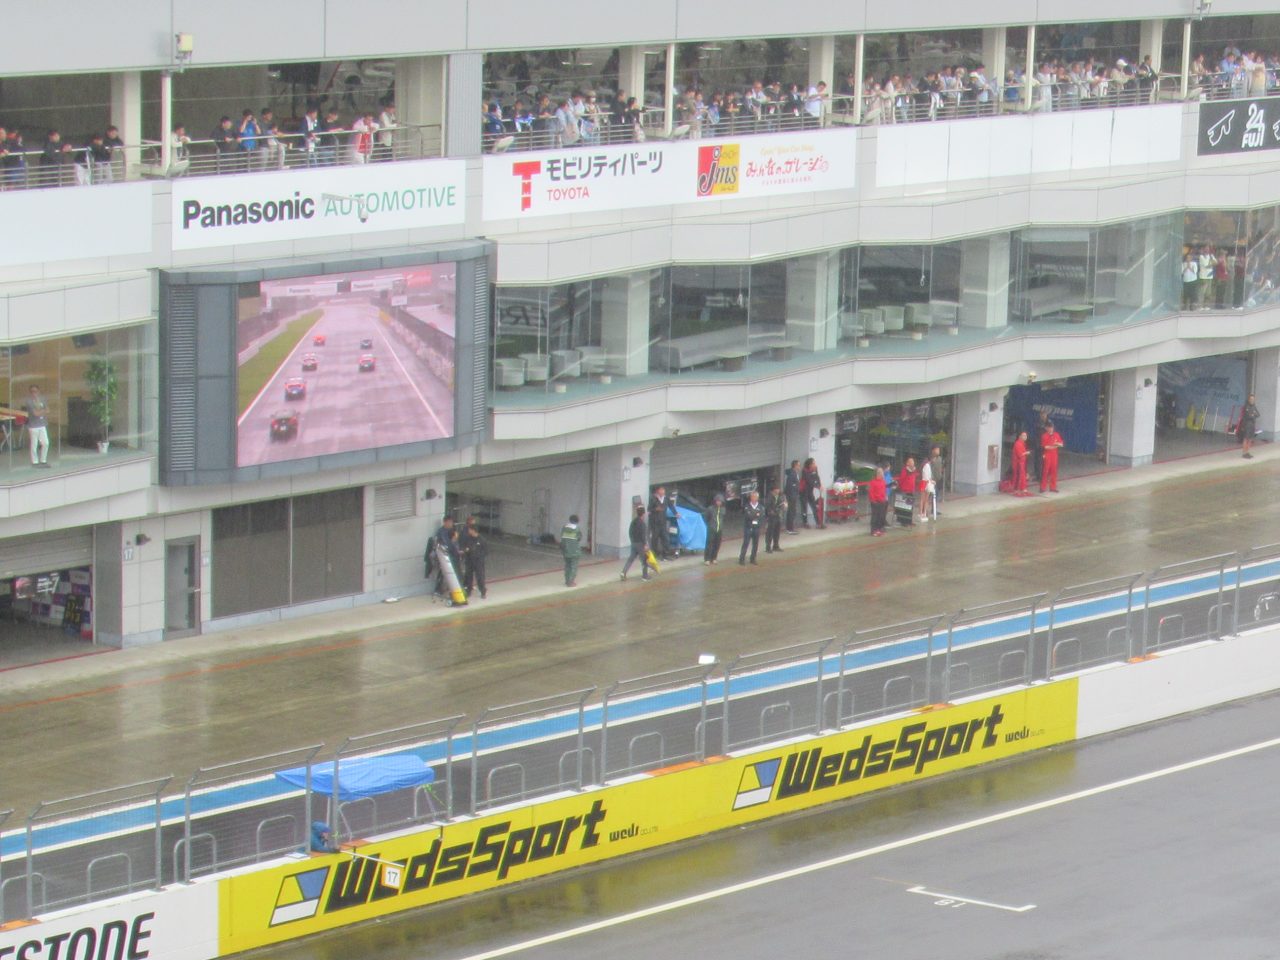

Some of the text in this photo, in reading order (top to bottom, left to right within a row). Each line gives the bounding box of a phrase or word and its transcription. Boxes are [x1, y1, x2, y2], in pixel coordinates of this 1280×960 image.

[546, 151, 663, 181] モビリティパーツ
[183, 185, 456, 229] Panasonic AUTOMOTIVE
[547, 186, 590, 201] TOYOTA
[776, 704, 1004, 801] WedsSport
[387, 870, 398, 884] 17
